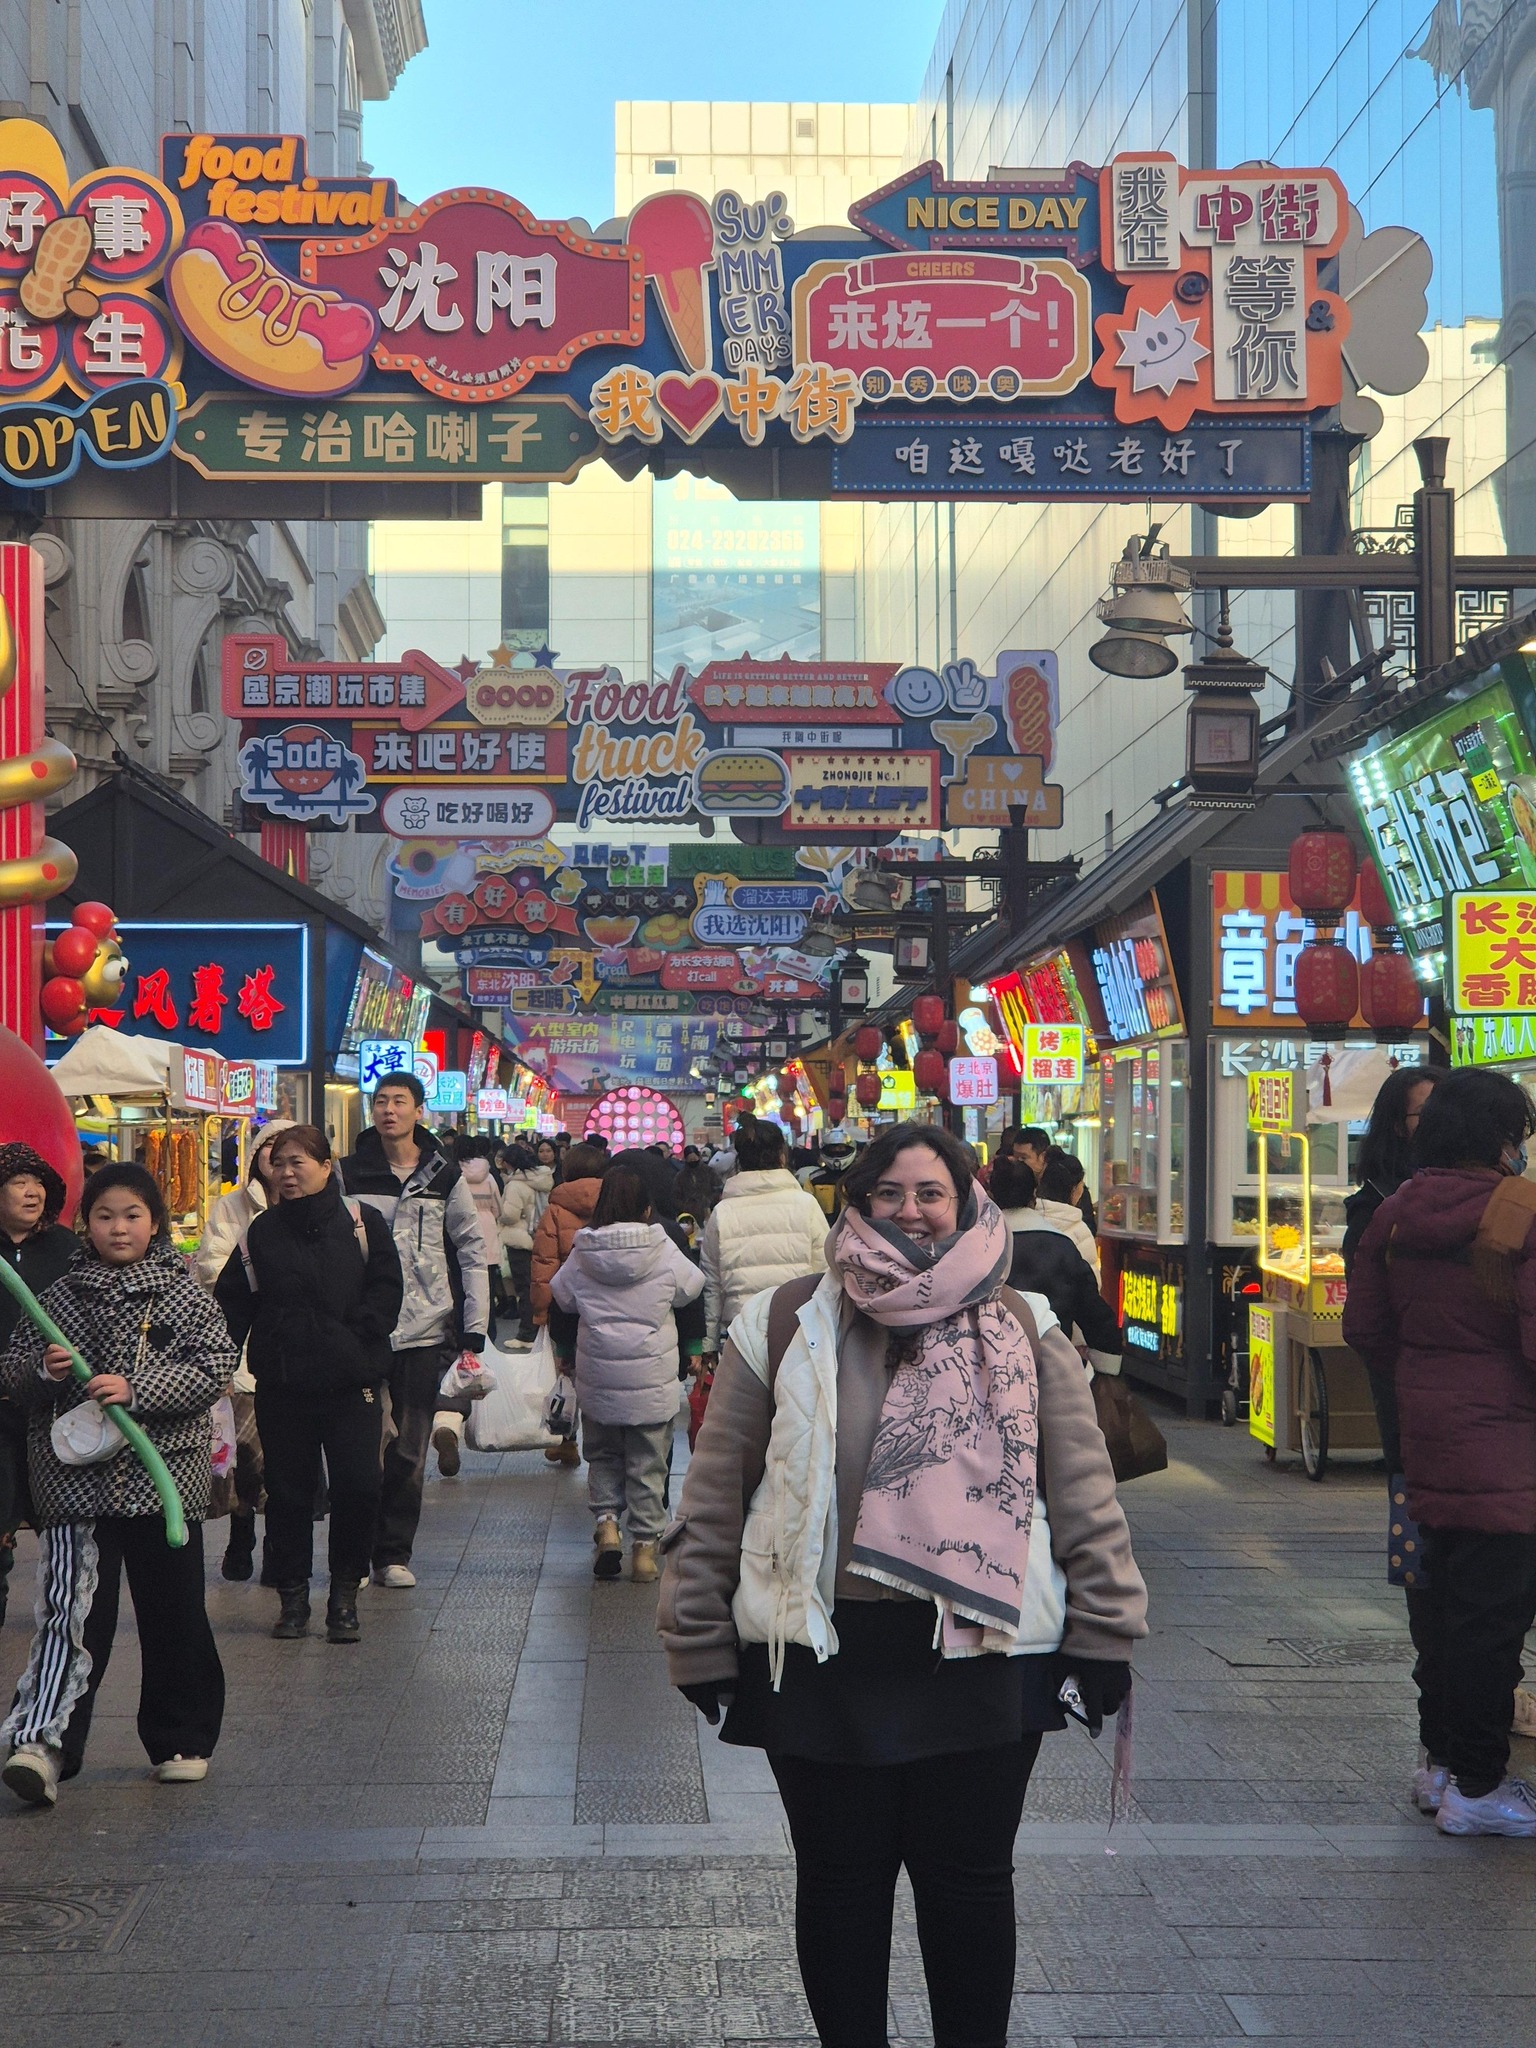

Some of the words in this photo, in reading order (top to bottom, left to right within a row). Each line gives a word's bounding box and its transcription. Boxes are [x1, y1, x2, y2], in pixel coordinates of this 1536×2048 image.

[179, 136, 298, 189] food
[208, 178, 387, 226] festival
[906, 197, 1000, 229] NICE
[1008, 197, 1088, 229] DAY
[1119, 166, 1169, 264] 我在
[1196, 183, 1320, 243] 中街
[721, 248, 779, 292] MM
[906, 261, 975, 278] CHEERS
[377, 241, 558, 333] 沈阳
[726, 292, 785, 334] ER
[1227, 255, 1299, 396] 等你
[729, 335, 790, 365] DAYS
[724, 366, 855, 438] 中街
[1, 393, 167, 470] OPEN
[236, 410, 543, 464] 专治哈喇子
[242, 674, 426, 706] 盛京潮玩市集
[476, 684, 554, 707] GOOD
[567, 665, 687, 722] Food
[266, 738, 342, 769] Soda
[373, 732, 546, 772] 来吧好使
[574, 716, 705, 781] truck
[822, 770, 873, 782] ZHONGJIE
[986, 763, 994, 783] I
[436, 802, 534, 824] 吃好喝好
[579, 778, 690, 829] festival
[962, 788, 1048, 811] CHINA
[742, 888, 809, 905] 溜达去哪
[89, 962, 285, 1034] 风薯塔
[528, 1021, 599, 1038] 大型室内
[1039, 1030, 1060, 1052] 烤
[548, 1038, 600, 1054] 游乐场
[955, 1061, 993, 1077] 老北京
[1032, 1058, 1076, 1079] 榴莲
[955, 1079, 995, 1099] 爆肚
